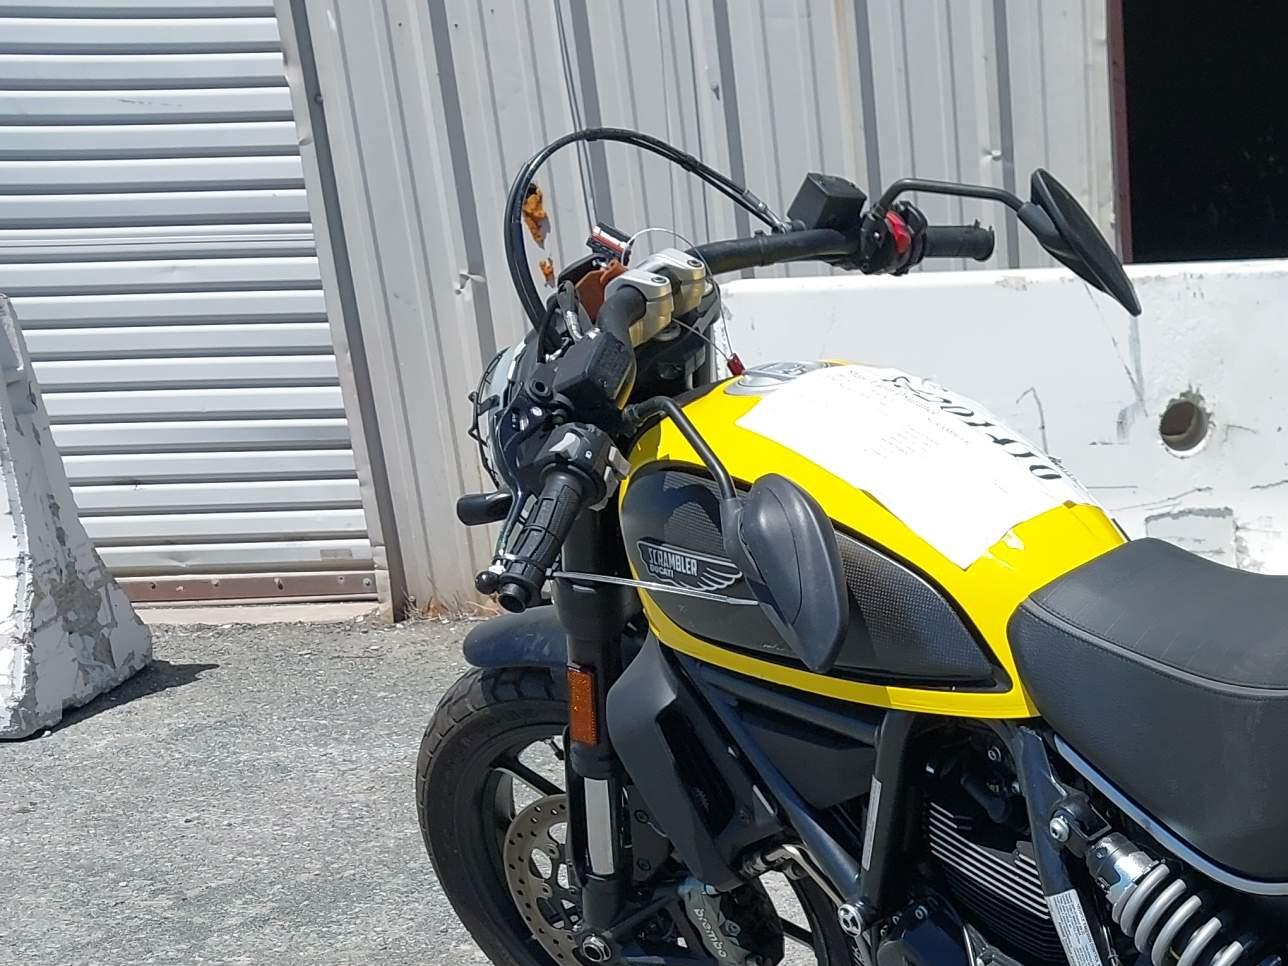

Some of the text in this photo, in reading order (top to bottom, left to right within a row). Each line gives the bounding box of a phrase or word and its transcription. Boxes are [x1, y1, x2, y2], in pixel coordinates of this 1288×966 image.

[647, 547, 698, 577] SCRAMBLER
[649, 564, 674, 578] DUCATI
[694, 908, 727, 958] brembo
